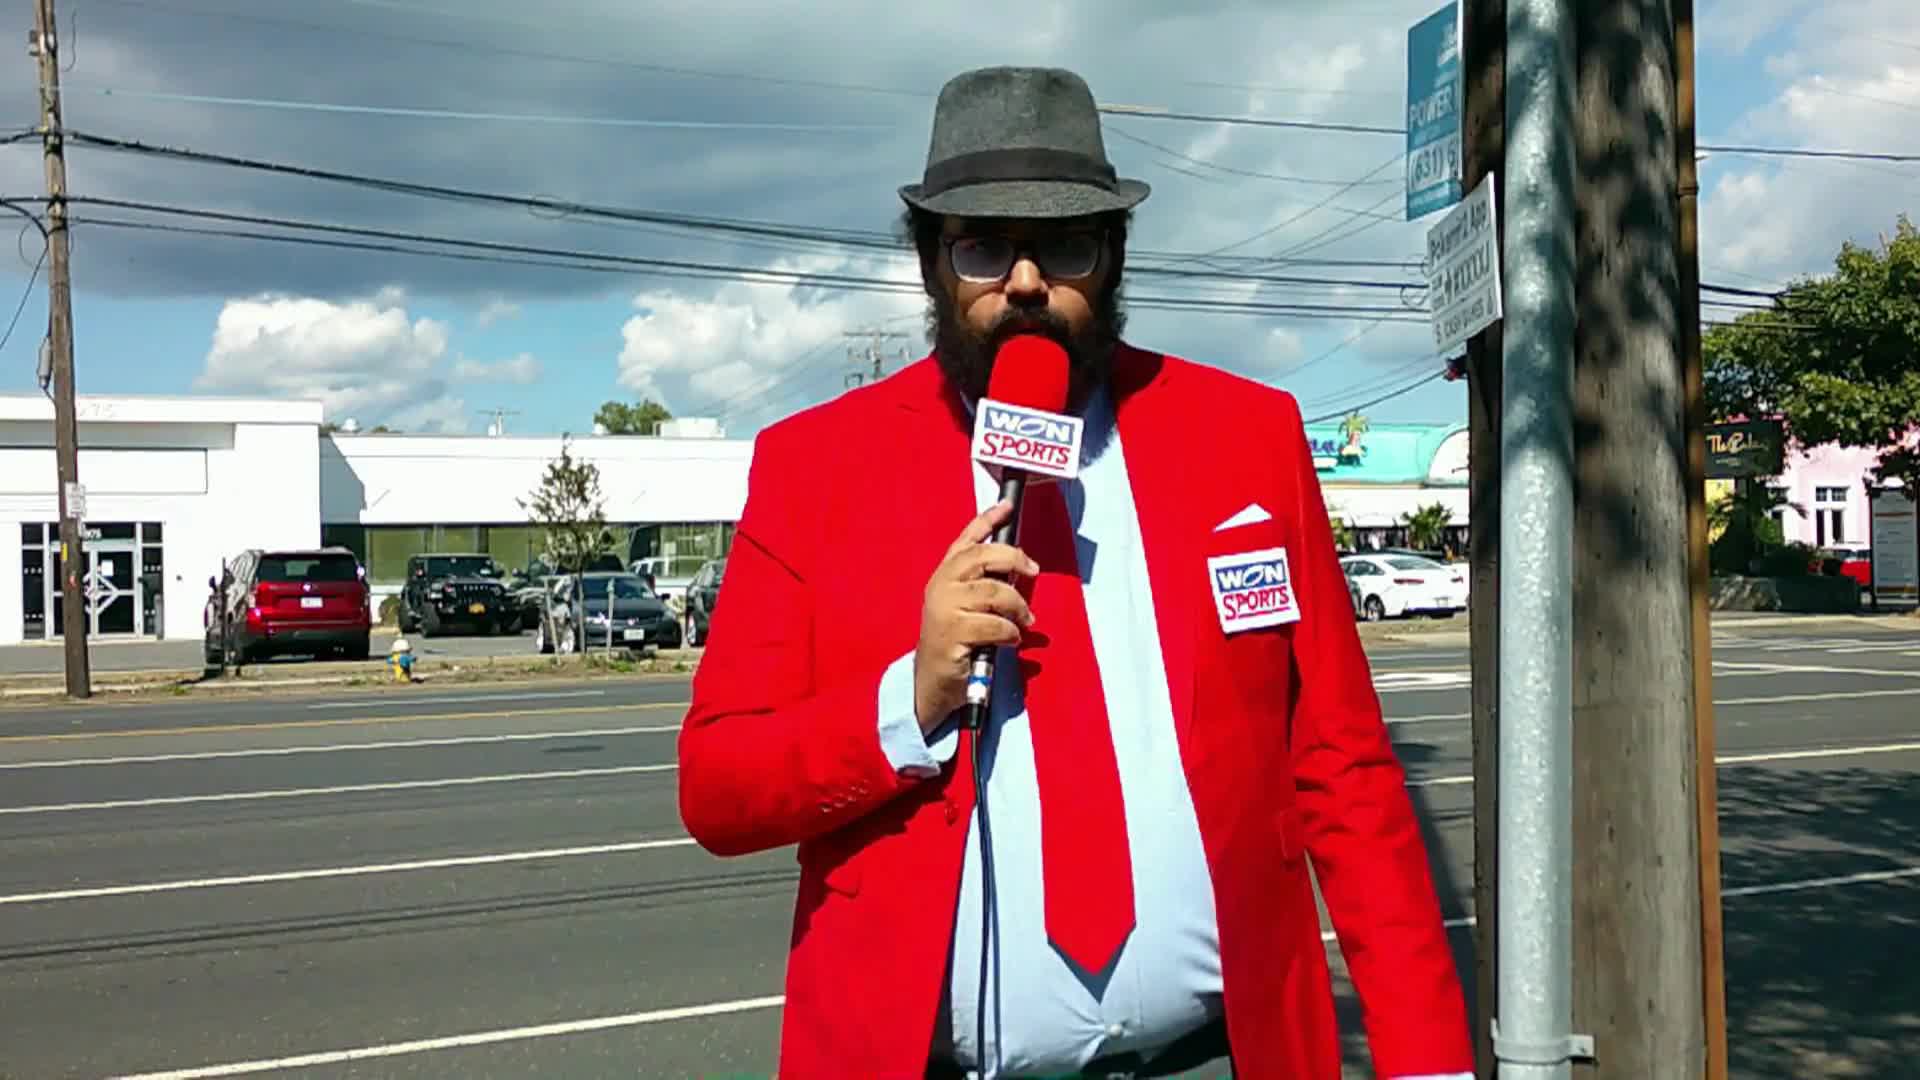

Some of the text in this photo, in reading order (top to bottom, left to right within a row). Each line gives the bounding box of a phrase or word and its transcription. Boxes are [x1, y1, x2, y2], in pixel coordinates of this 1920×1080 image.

[1409, 84, 1453, 128] POWER
[1410, 145, 1442, 190] (631)
[988, 410, 1071, 443] WON
[980, 431, 1071, 465] SPORTS
[1217, 560, 1284, 590] WON
[1223, 585, 1289, 621] SPORTS
